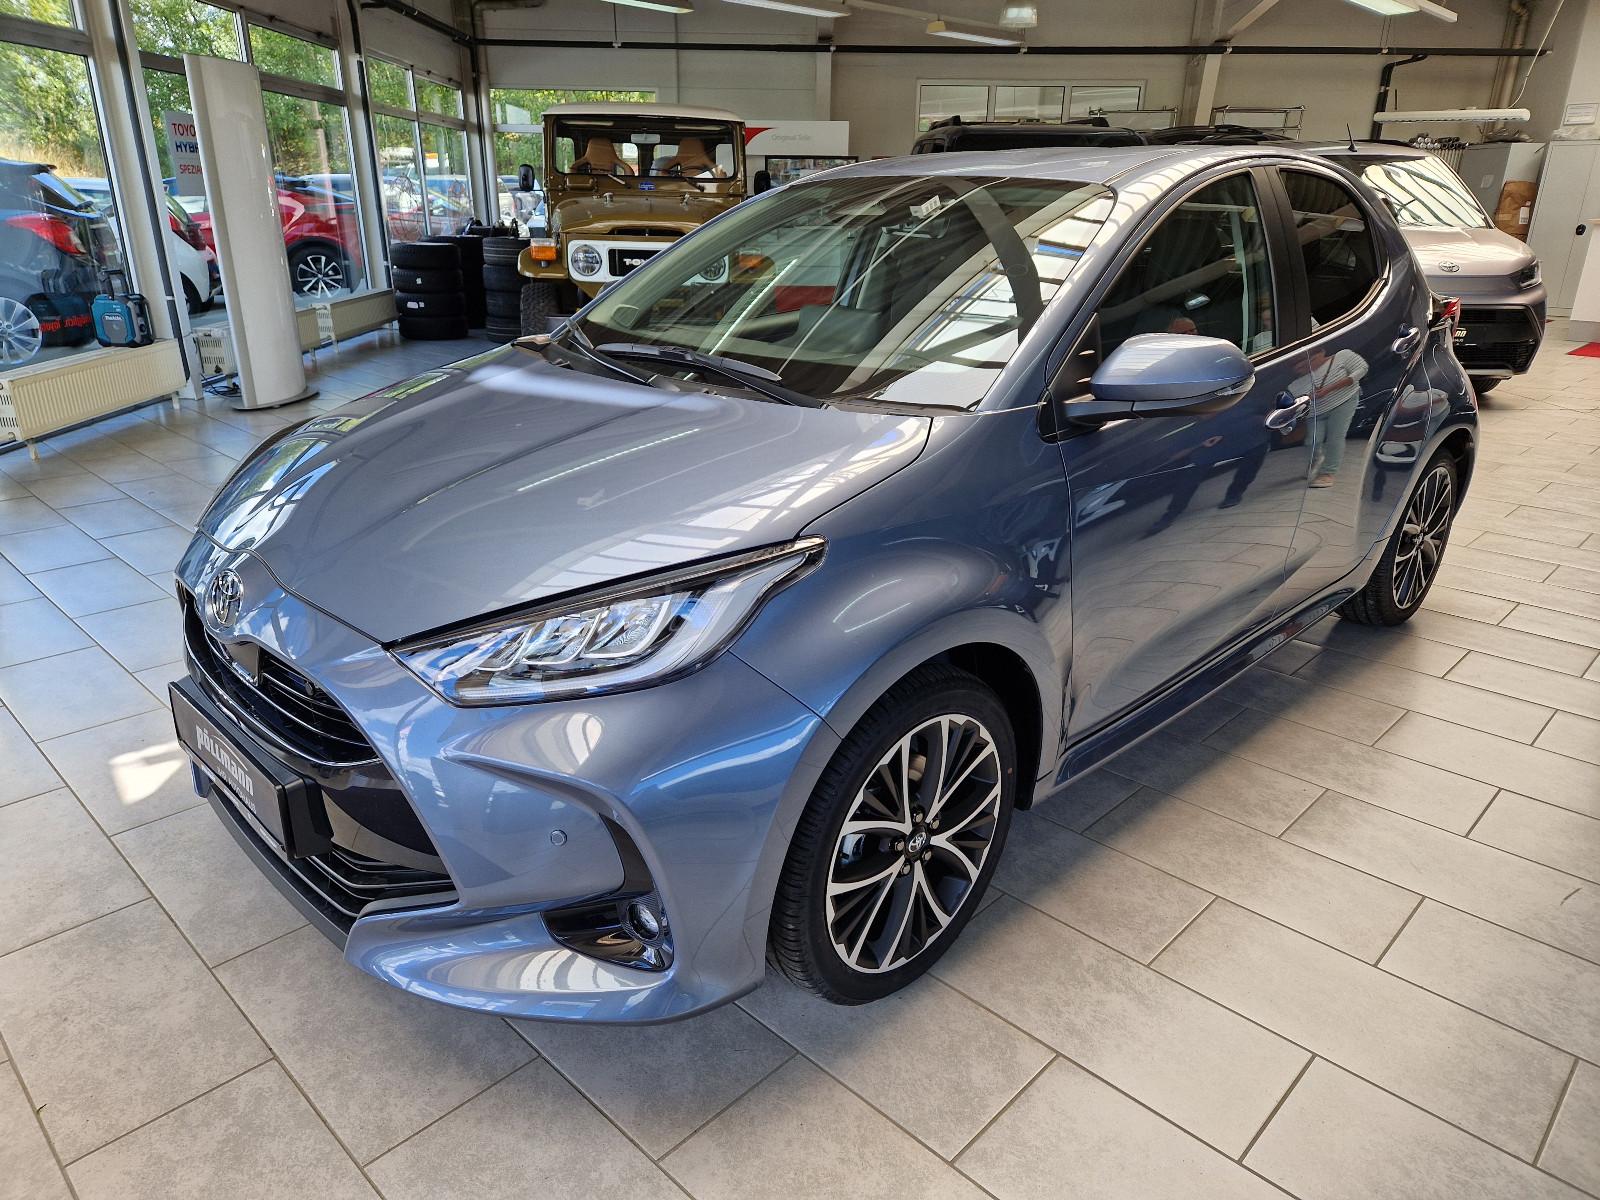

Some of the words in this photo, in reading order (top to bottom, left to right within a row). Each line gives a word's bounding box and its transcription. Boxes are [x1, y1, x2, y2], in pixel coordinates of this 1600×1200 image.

[171, 123, 196, 137] TOYO
[175, 141, 199, 153] HYBR
[180, 164, 203, 175] SPEZIA
